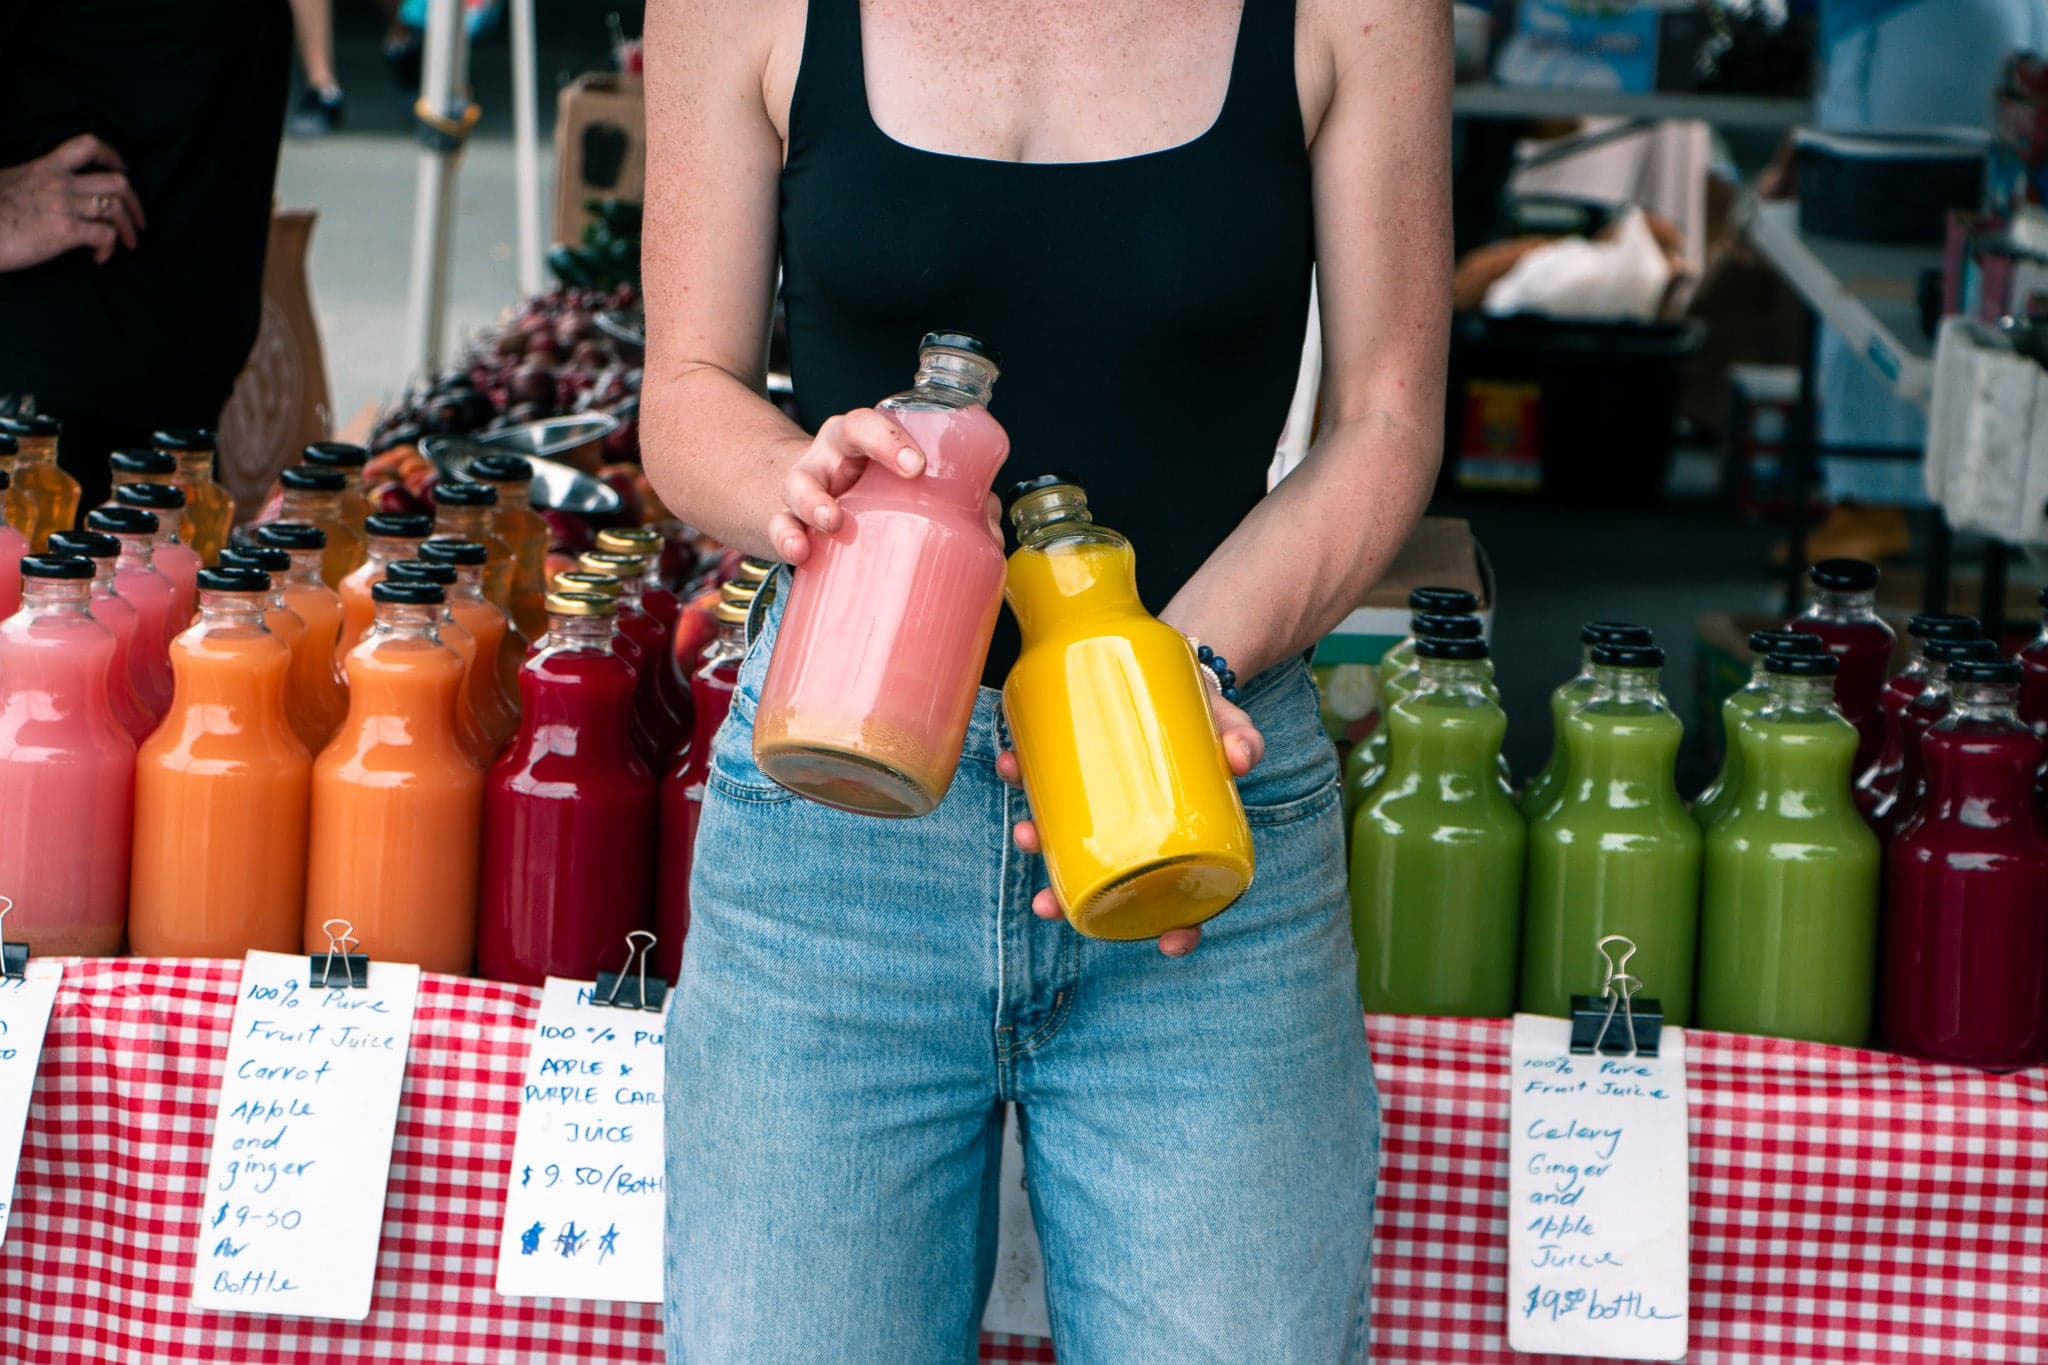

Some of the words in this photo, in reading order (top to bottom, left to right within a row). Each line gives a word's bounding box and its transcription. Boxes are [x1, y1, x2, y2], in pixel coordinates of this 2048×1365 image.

[246, 978, 300, 1009] 100%
[322, 989, 392, 1013] Pure
[246, 1020, 323, 1044] Fruit
[330, 1026, 395, 1050] Juice
[634, 1031, 664, 1048] PU
[238, 1059, 333, 1084] Carrot
[539, 1057, 604, 1076] APPLE
[1524, 1056, 1573, 1075] 100%
[1600, 1061, 1653, 1077] Pure
[524, 1085, 599, 1105] PURPLE
[615, 1087, 662, 1105] CAR
[1524, 1080, 1587, 1095] Fruit
[1597, 1081, 1669, 1100] Juice
[230, 1098, 315, 1124] Apple
[232, 1125, 288, 1150] and
[1527, 1118, 1624, 1160] Celery
[218, 1154, 316, 1193] ginger
[1528, 1152, 1613, 1192] Ginger
[1529, 1186, 1586, 1206] and
[1527, 1215, 1595, 1239] Apple
[1531, 1244, 1624, 1268] Juice
[212, 1269, 300, 1296] Bottle
[1588, 1288, 1683, 1320] bottle
